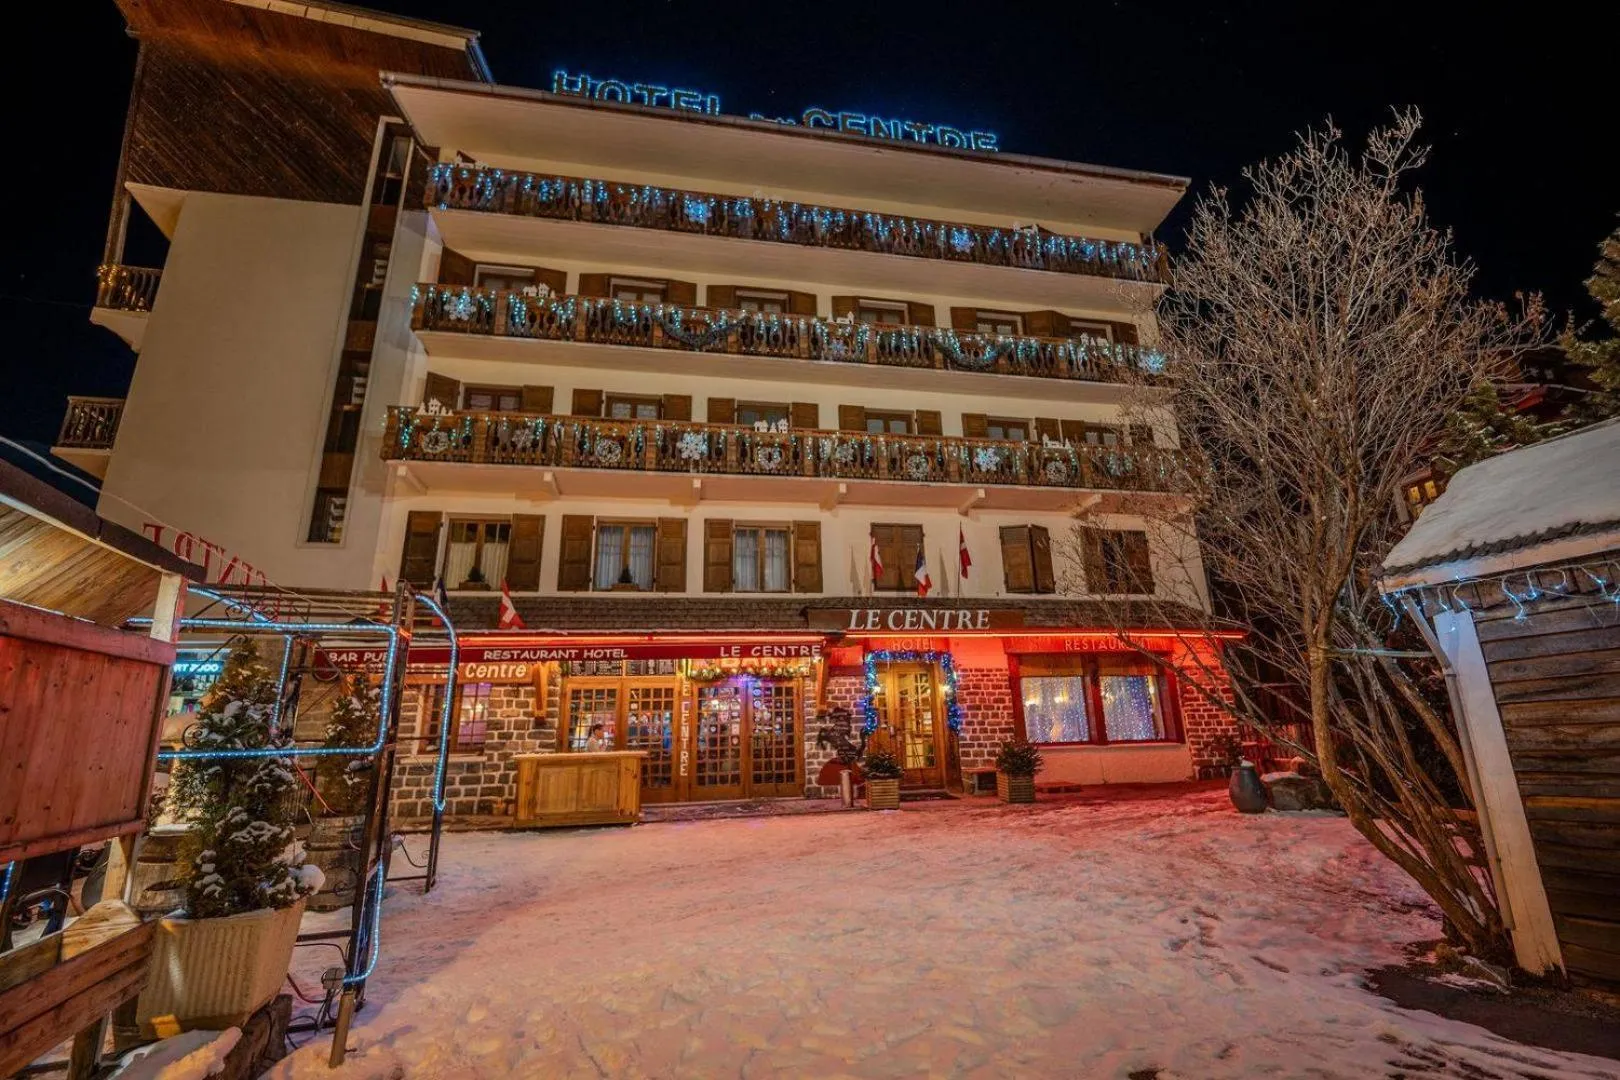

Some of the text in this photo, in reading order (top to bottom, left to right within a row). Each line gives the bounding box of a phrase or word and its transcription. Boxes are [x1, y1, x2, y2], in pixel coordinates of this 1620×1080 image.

[847, 609, 991, 631] LE CENTRE
[892, 638, 936, 651] HOTEL
[1064, 639, 1152, 651] RESTAURT
[329, 651, 358, 662] BAR
[483, 648, 628, 660] RESTAURANT HOTEL
[720, 645, 821, 657] LE CENTRE
[465, 662, 528, 679] Centre
[680, 701, 692, 776] CENTRE
